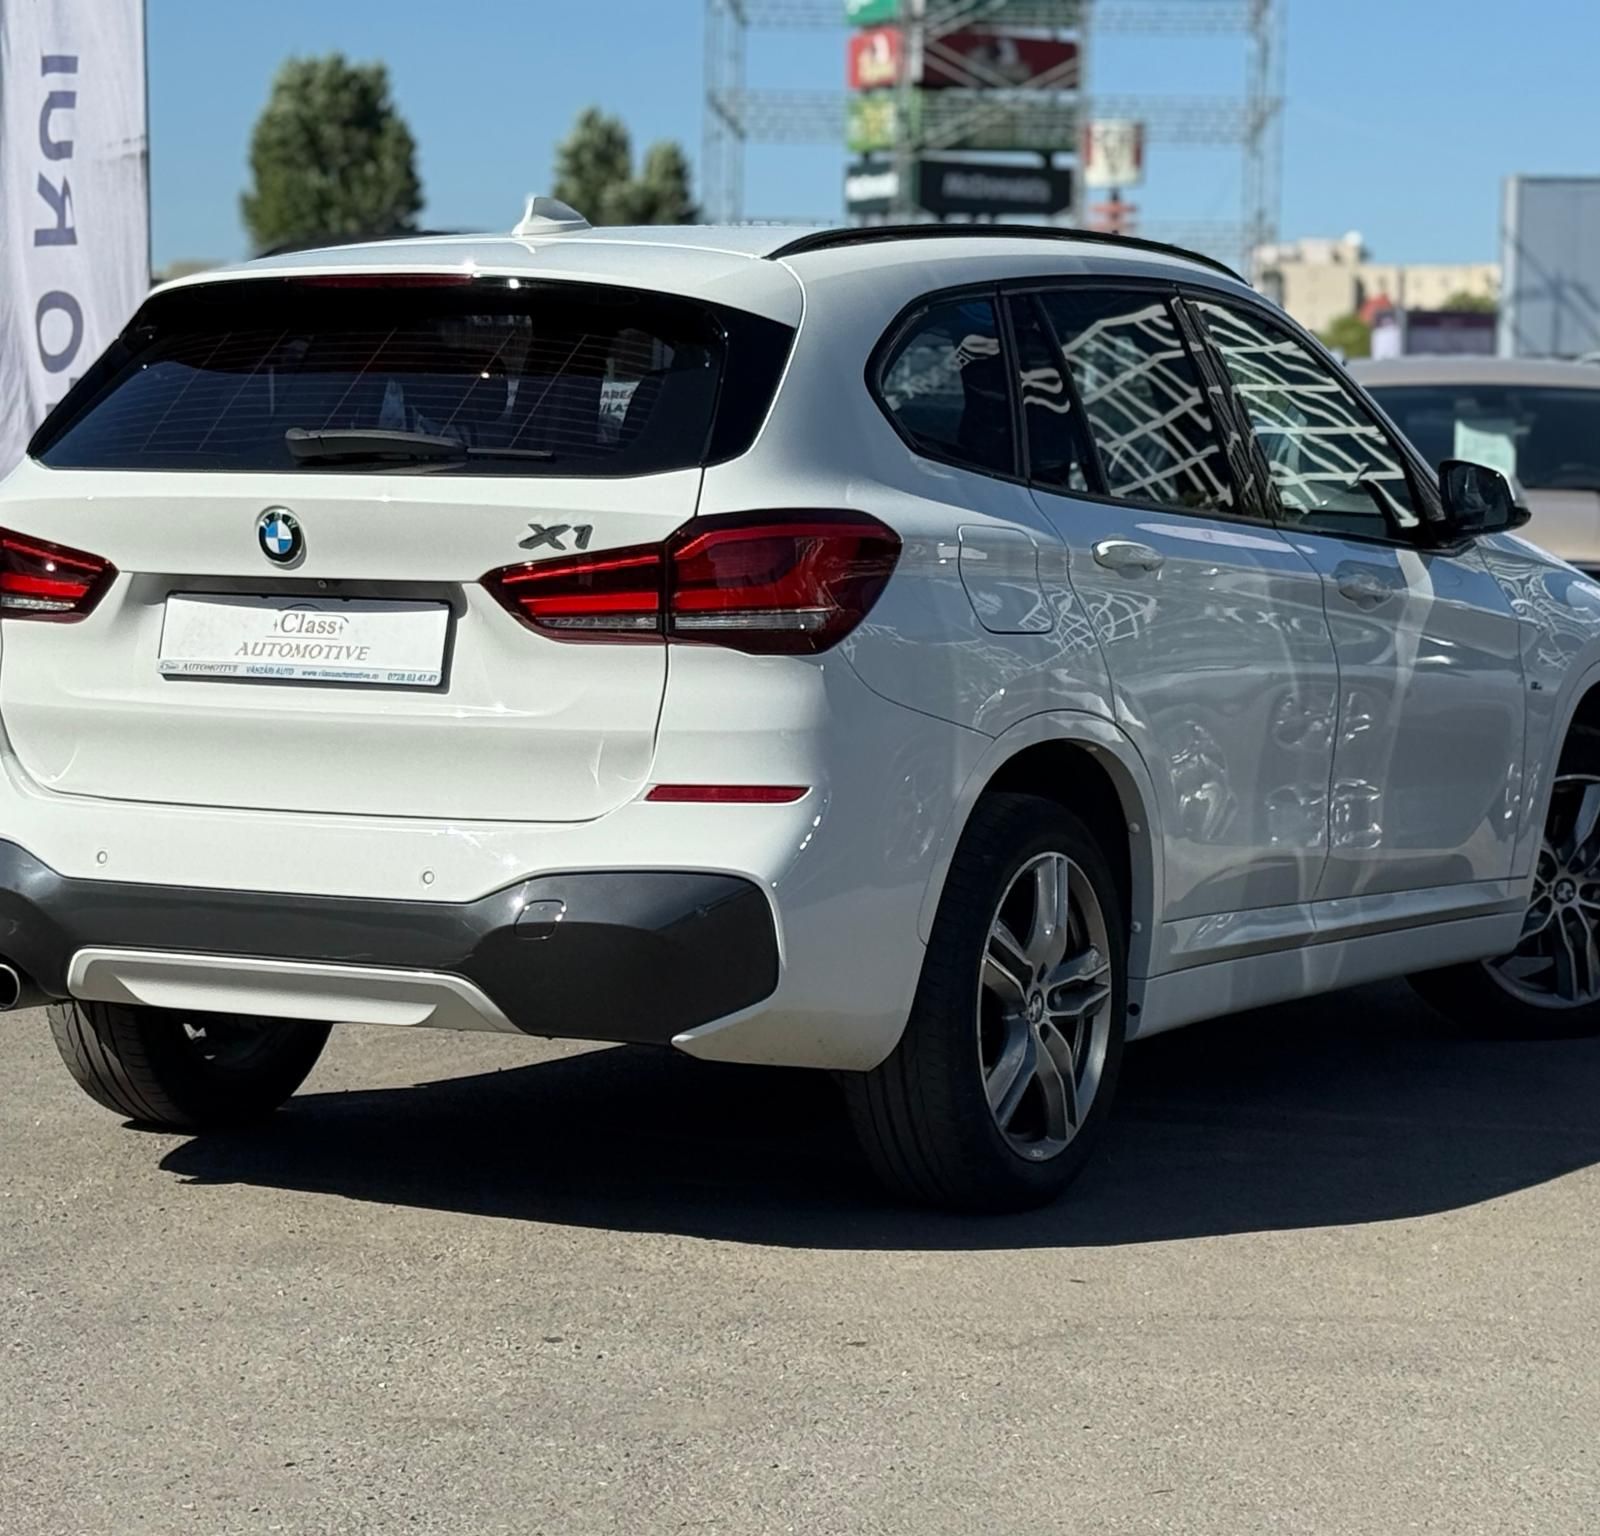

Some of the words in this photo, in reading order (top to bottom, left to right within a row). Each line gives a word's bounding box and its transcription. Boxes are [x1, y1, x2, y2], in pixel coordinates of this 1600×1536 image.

[518, 523, 594, 551] X1
[280, 612, 338, 635] Class
[234, 641, 372, 661] AUTOMOTIVE
